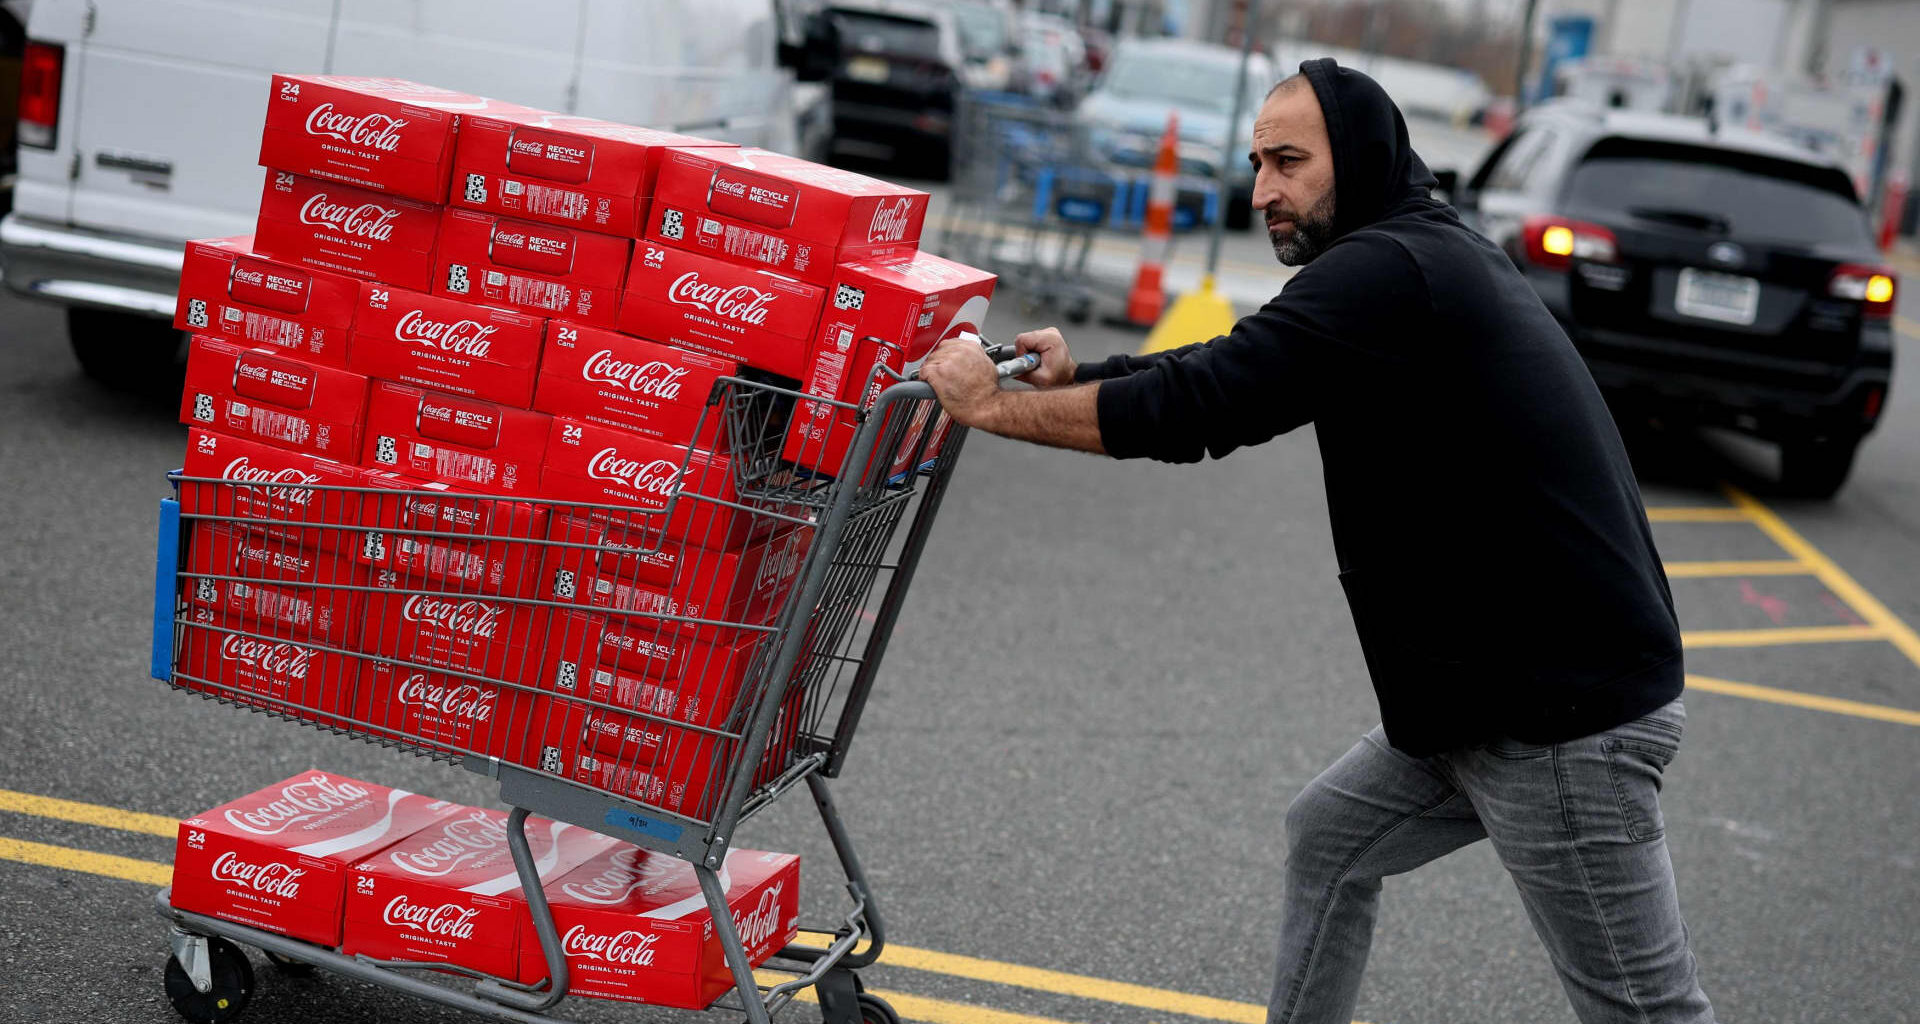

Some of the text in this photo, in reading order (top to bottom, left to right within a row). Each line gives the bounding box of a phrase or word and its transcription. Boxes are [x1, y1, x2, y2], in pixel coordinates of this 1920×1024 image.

[281, 81, 300, 96] 24
[280, 93, 298, 103] Cans
[305, 102, 410, 152] Coca-Cola
[321, 143, 381, 161] ORIGINAL TASTE
[546, 152, 560, 161] ME
[547, 144, 585, 158] RECYCLE
[275, 172, 294, 186] 24
[275, 183, 292, 193] Cans
[750, 186, 789, 203] RECYCLE
[749, 193, 762, 203] ME
[300, 193, 402, 242] Coca-Cola
[867, 197, 913, 243] Coca-Cola
[314, 232, 372, 250] ORIGINAL TASTE
[528, 243, 541, 252] ME
[529, 236, 567, 250] RECYCLE
[644, 247, 665, 262] 24
[643, 259, 662, 269] Cans
[266, 282, 278, 291] ME
[267, 275, 303, 289] RECYCLE
[369, 288, 389, 303] 24
[668, 271, 779, 326] Coca-Cola
[369, 300, 388, 310] Cans
[683, 312, 745, 334] ORIGINAL TASTE
[395, 309, 500, 358] Coca-Cola
[557, 327, 578, 342] 24
[557, 339, 575, 349] Cans
[411, 350, 471, 367] ORIGINAL TASTE
[270, 377, 284, 386] ME
[271, 370, 308, 385] RECYCLE
[582, 349, 690, 400] Coca-Cola
[598, 390, 660, 409] ORIGINAL TASTE
[455, 417, 468, 426] ME
[456, 410, 493, 424] RECYCLE
[562, 424, 583, 439] 24
[198, 435, 217, 448] 24
[562, 436, 580, 446] Cans
[197, 446, 215, 456] Cans
[603, 488, 664, 507] ORIGINAL TASTE
[272, 503, 294, 514] TASE
[378, 569, 398, 583] 24
[457, 638, 479, 647] TASE
[637, 646, 650, 656] ME
[224, 774, 370, 835] Coca-Cola
[188, 830, 206, 844] 24
[187, 841, 204, 850] Cans
[211, 851, 307, 900] Coca-Cola
[357, 876, 375, 889] 24
[226, 889, 281, 907] ORIGINAL TASTE
[356, 887, 374, 896] Cans
[383, 895, 481, 940] Coca-Cola
[703, 921, 713, 935] 24
[399, 933, 457, 948] ORIGINAL TASTE
[561, 924, 661, 967] Coca-Cola
[577, 963, 637, 976] ORIGINAL TASTE
